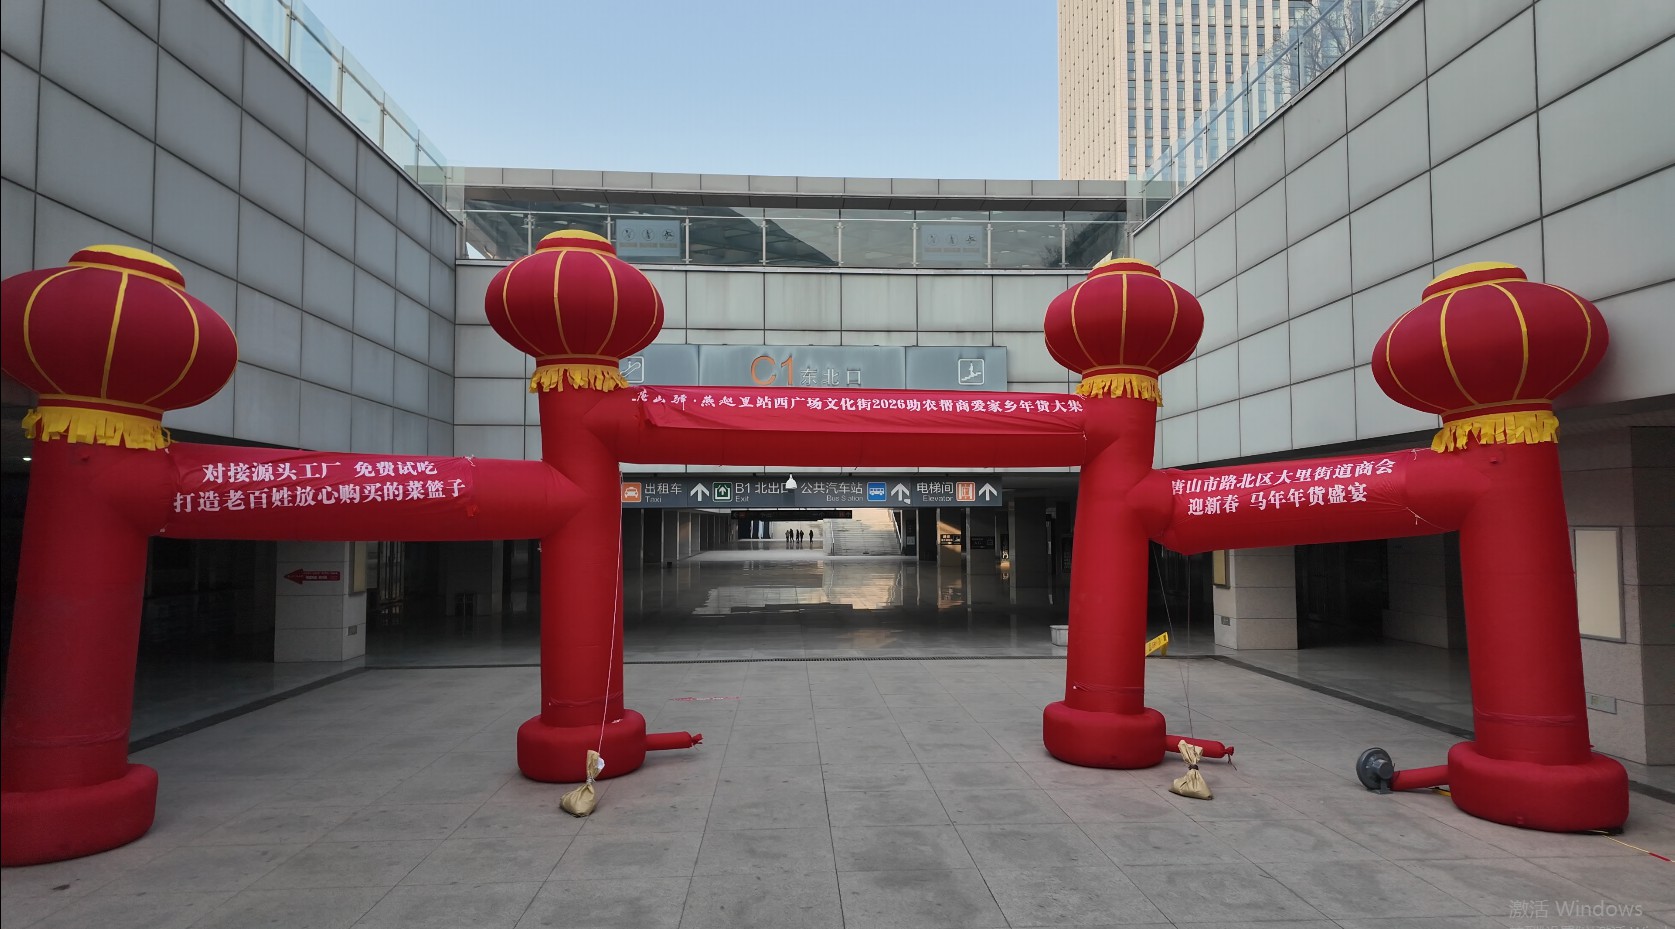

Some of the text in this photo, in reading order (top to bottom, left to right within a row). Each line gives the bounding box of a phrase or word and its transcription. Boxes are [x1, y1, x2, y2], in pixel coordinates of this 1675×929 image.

[750, 355, 862, 386] C1 东北口
[202, 460, 438, 484] 对接源头工厂 免费试吃
[1171, 458, 1396, 495] 唐山市路北区大里街道商会
[173, 478, 466, 513] 打造老百姓放心购买的菜篮子
[644, 482, 682, 494] 出租车
[735, 482, 751, 494] B1
[800, 482, 863, 494] 公共汽车站
[916, 482, 953, 494] 电梯间
[735, 495, 749, 503] Exit
[1187, 482, 1368, 516] 迎新春 马年年货盛宴
